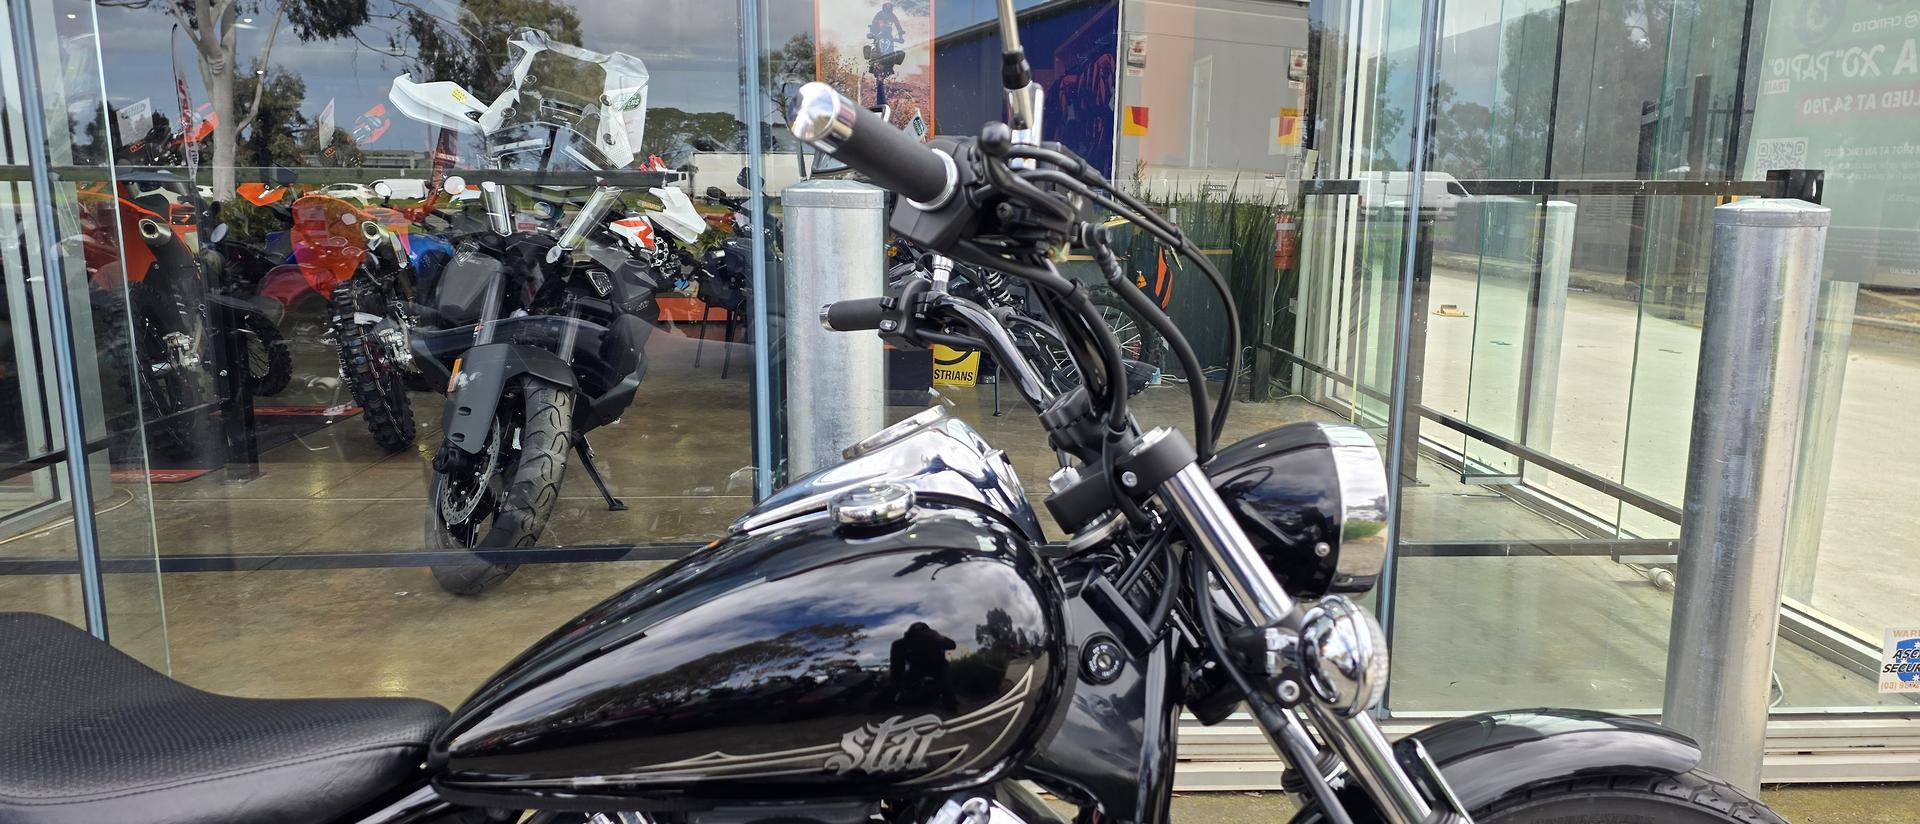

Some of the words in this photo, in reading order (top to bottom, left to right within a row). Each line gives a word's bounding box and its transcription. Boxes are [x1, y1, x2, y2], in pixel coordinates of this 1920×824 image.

[934, 369, 973, 381] STRIANS
[1893, 630, 1920, 638] WAR
[1892, 650, 1920, 659] ASC
[824, 714, 946, 776] star
